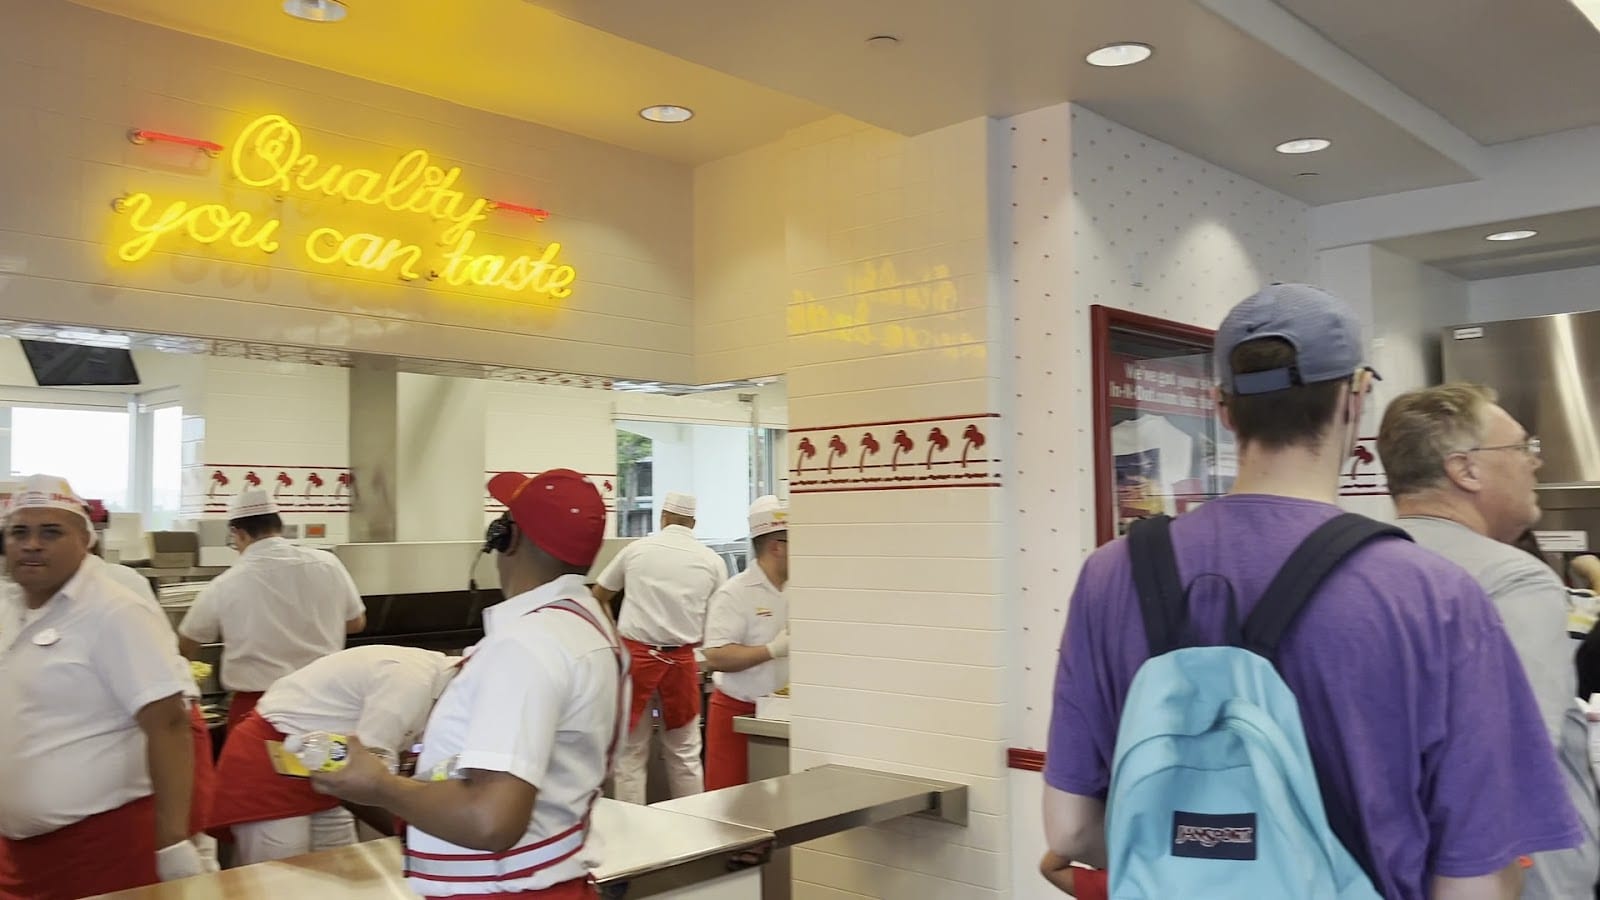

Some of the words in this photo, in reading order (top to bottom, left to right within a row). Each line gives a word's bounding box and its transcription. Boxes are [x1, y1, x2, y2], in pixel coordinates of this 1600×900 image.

[231, 114, 488, 243] Quality
[119, 192, 279, 262] you
[306, 227, 421, 279] can
[441, 230, 576, 298] taste
